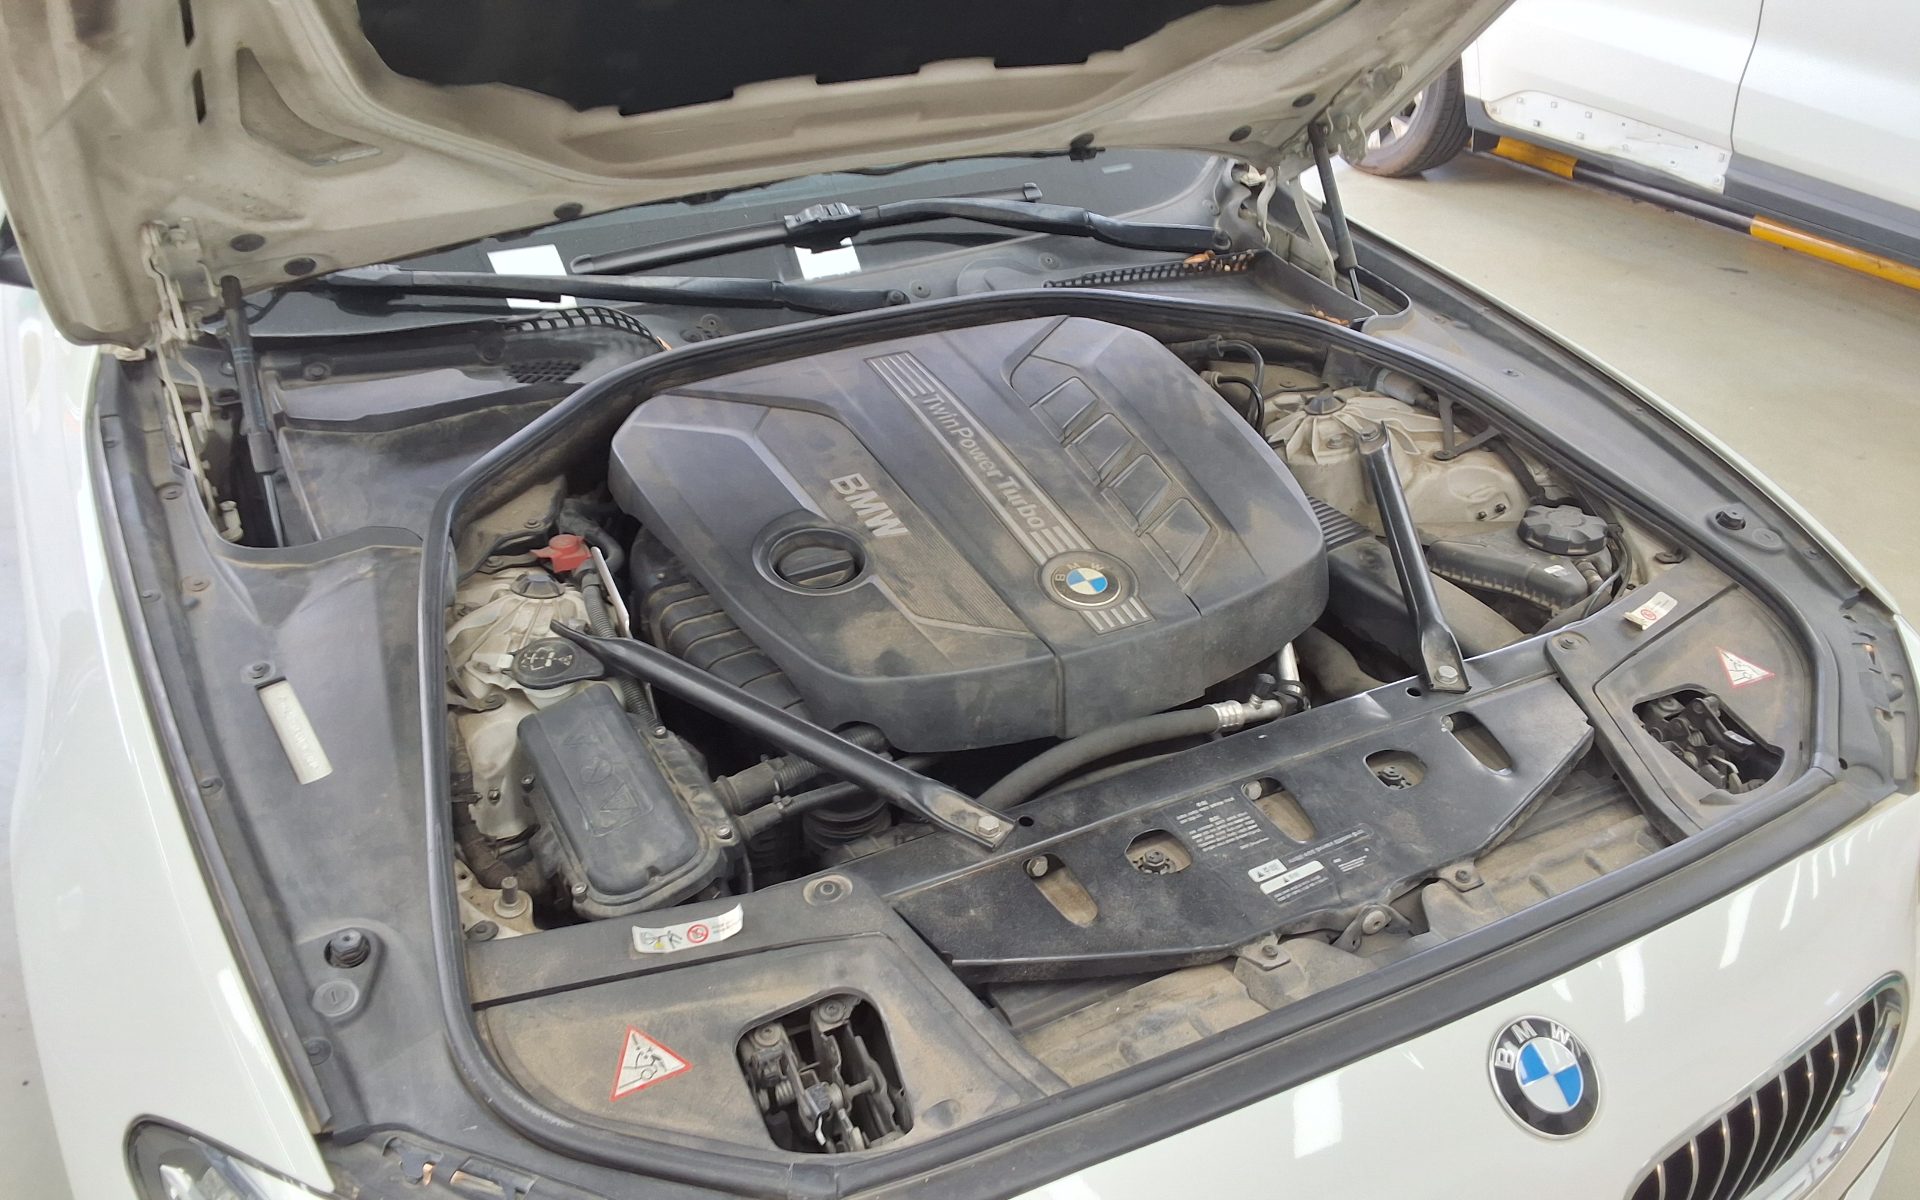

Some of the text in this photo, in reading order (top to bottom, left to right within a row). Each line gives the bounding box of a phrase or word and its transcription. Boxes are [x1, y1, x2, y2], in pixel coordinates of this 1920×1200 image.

[923, 394, 1045, 528] TwinPower Turbo
[830, 472, 909, 537] BMW
[1494, 1019, 1571, 1071] BMW
